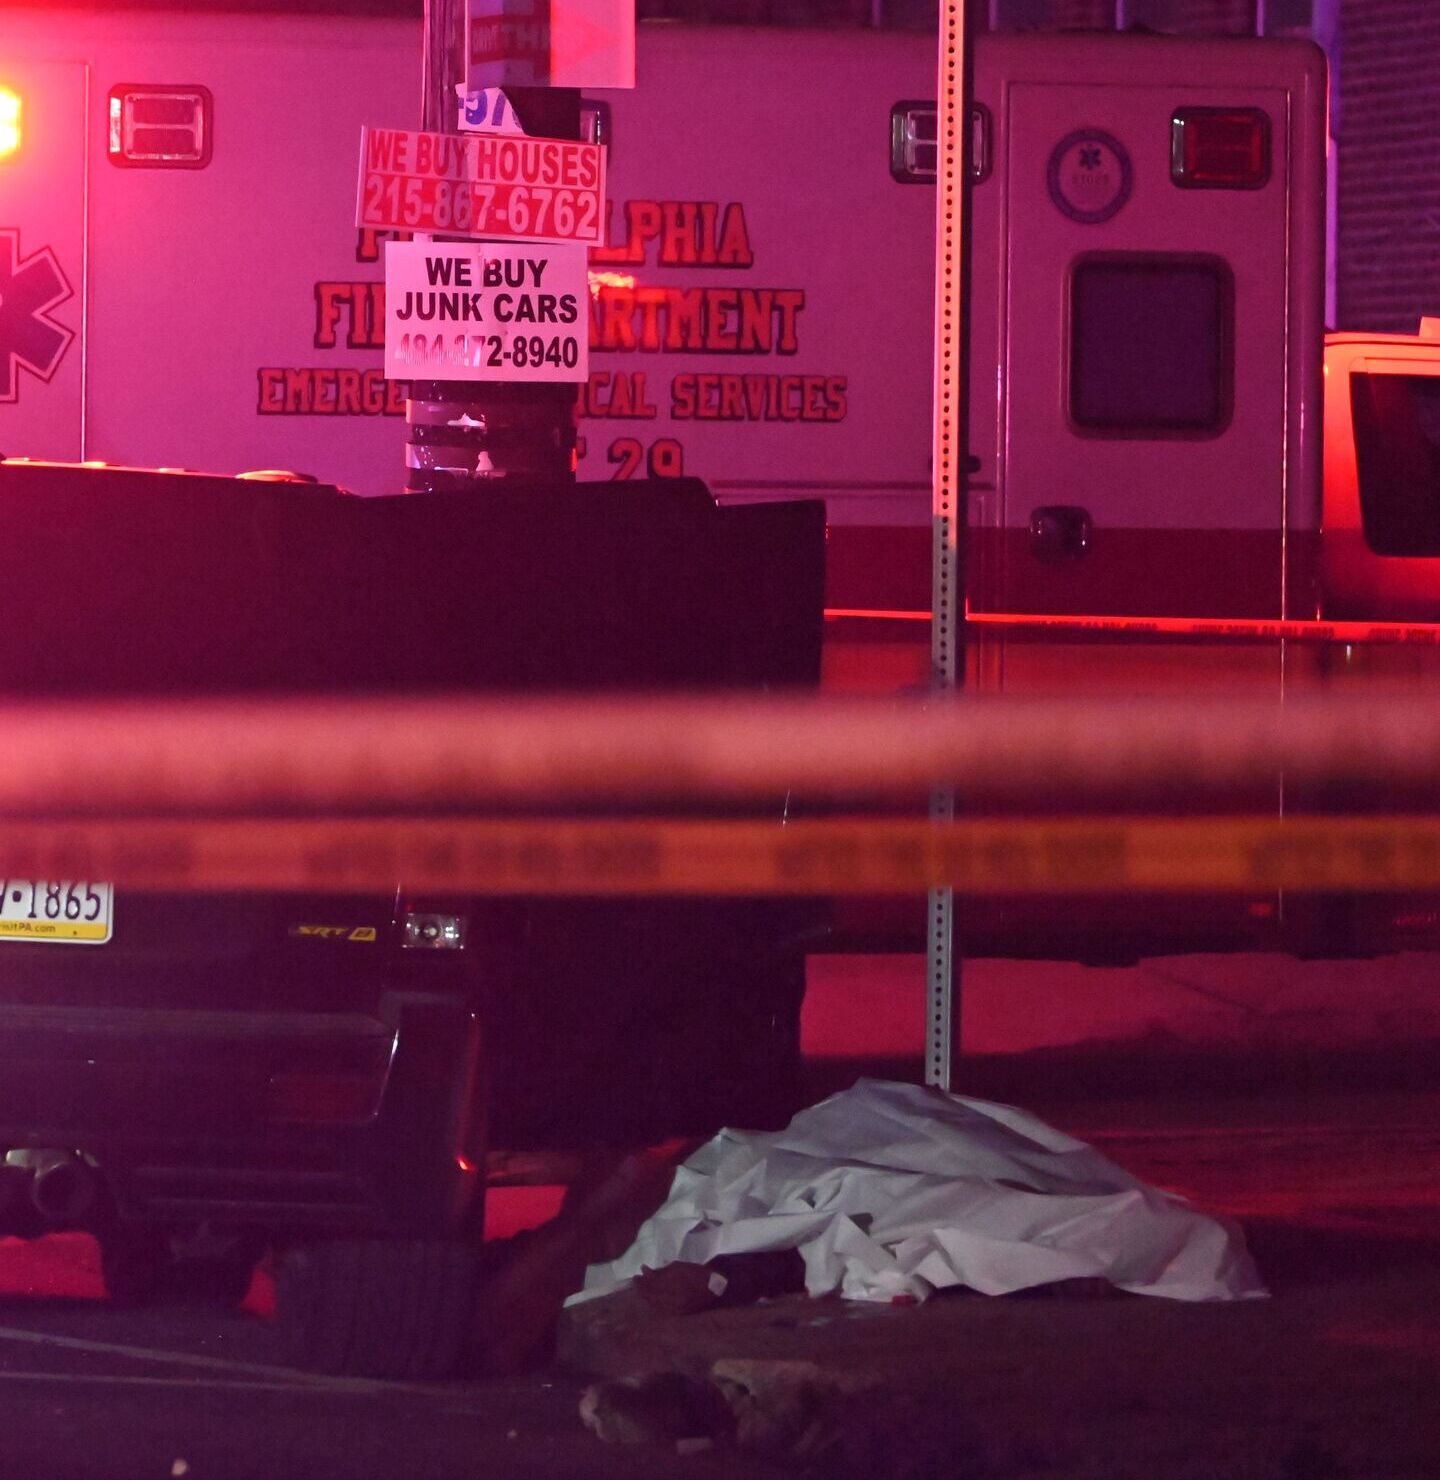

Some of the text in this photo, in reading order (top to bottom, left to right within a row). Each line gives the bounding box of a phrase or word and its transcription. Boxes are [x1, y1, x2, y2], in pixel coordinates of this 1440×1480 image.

[368, 130, 598, 188] WE BUY HOUSES
[364, 174, 598, 239] 215-867-6762
[425, 257, 548, 288] WE BUY
[314, 282, 805, 355] FI RTMENT
[396, 291, 578, 324] JUNK CARS
[257, 368, 848, 423] EMERGE ICAL SERVICES
